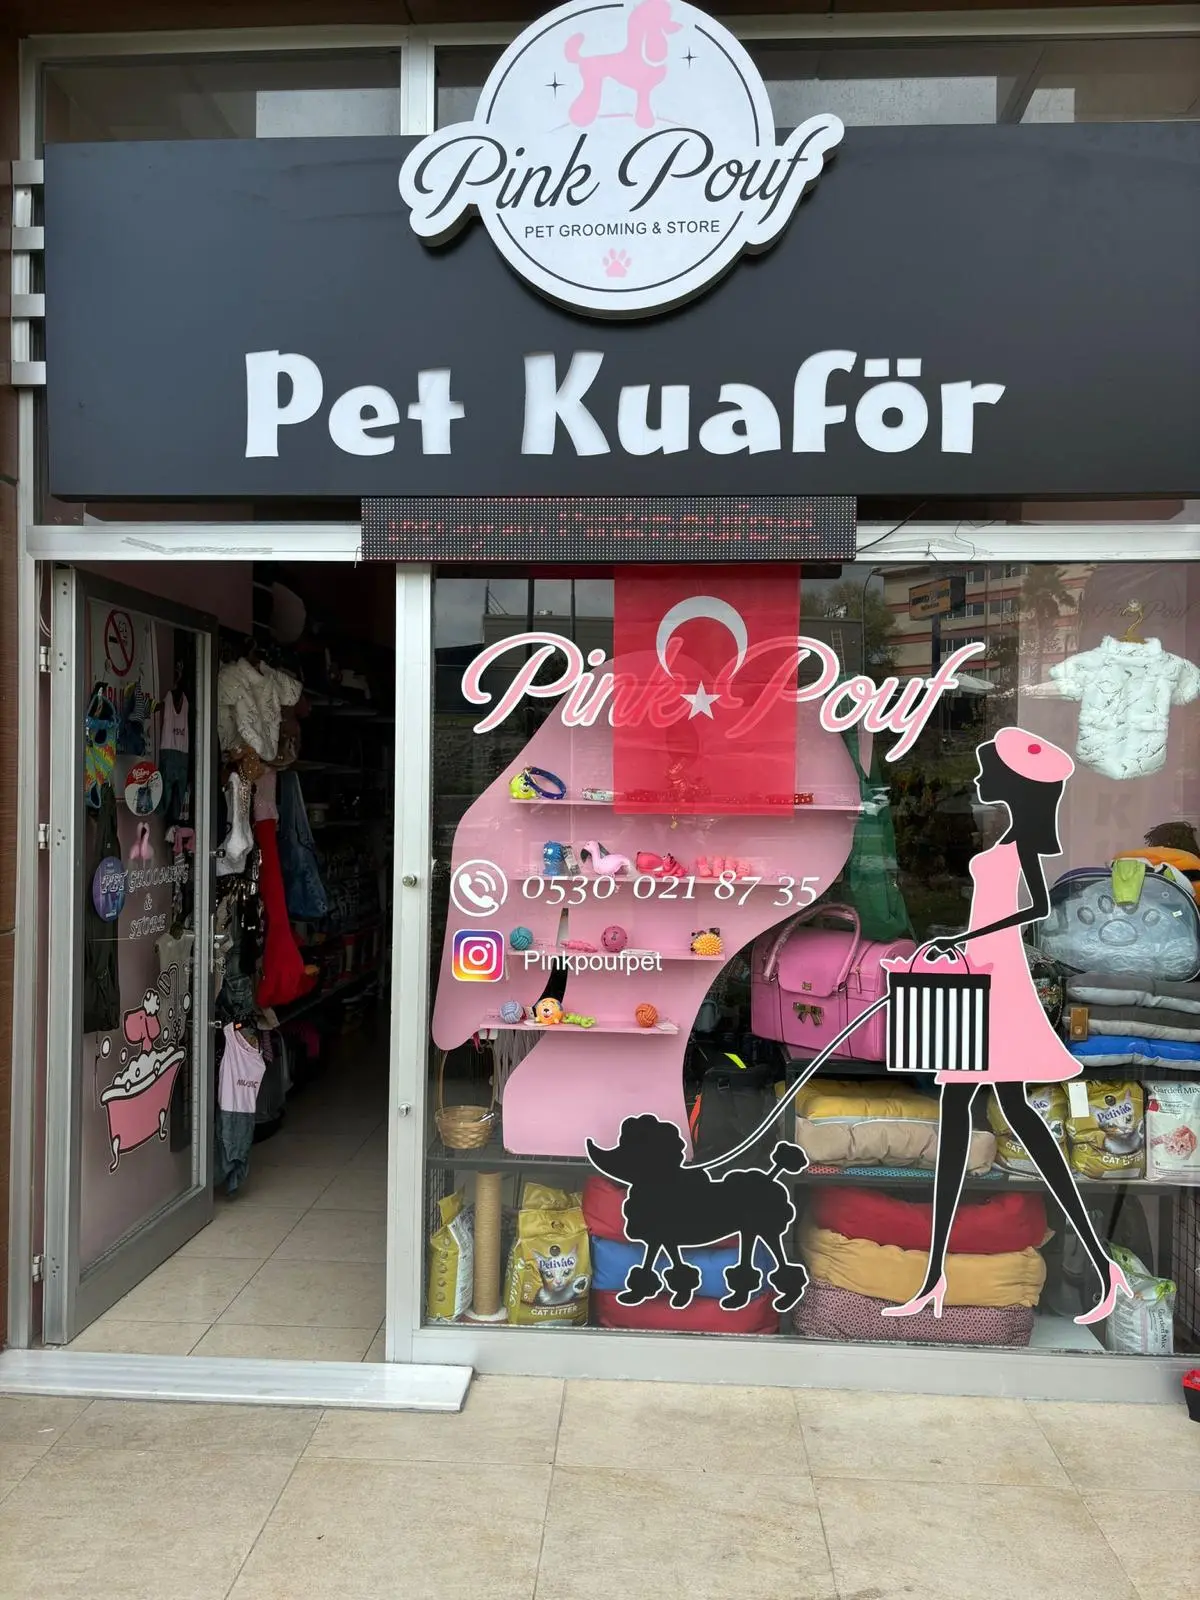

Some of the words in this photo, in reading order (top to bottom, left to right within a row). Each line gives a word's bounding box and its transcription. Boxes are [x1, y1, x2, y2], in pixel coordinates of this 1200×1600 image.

[414, 133, 600, 219] Pink
[617, 126, 830, 226] Pouf
[524, 223, 555, 239] PET
[558, 221, 648, 238] GROOMING
[652, 221, 662, 235] &
[666, 219, 721, 235] STORE
[244, 349, 465, 459] Pet
[521, 348, 1006, 457] Kuaför
[461, 631, 690, 735] Pink
[712, 635, 986, 763] Pouf
[521, 875, 616, 905] 0530
[632, 875, 696, 900] 021
[713, 870, 761, 908] 87
[772, 875, 820, 908] 35
[128, 913, 167, 939] STORE
[523, 949, 664, 976] Pinkpoufpet
[1102, 1155, 1120, 1165] CAT
[530, 1308, 549, 1316] CAT
[550, 1305, 578, 1316] LITTER
